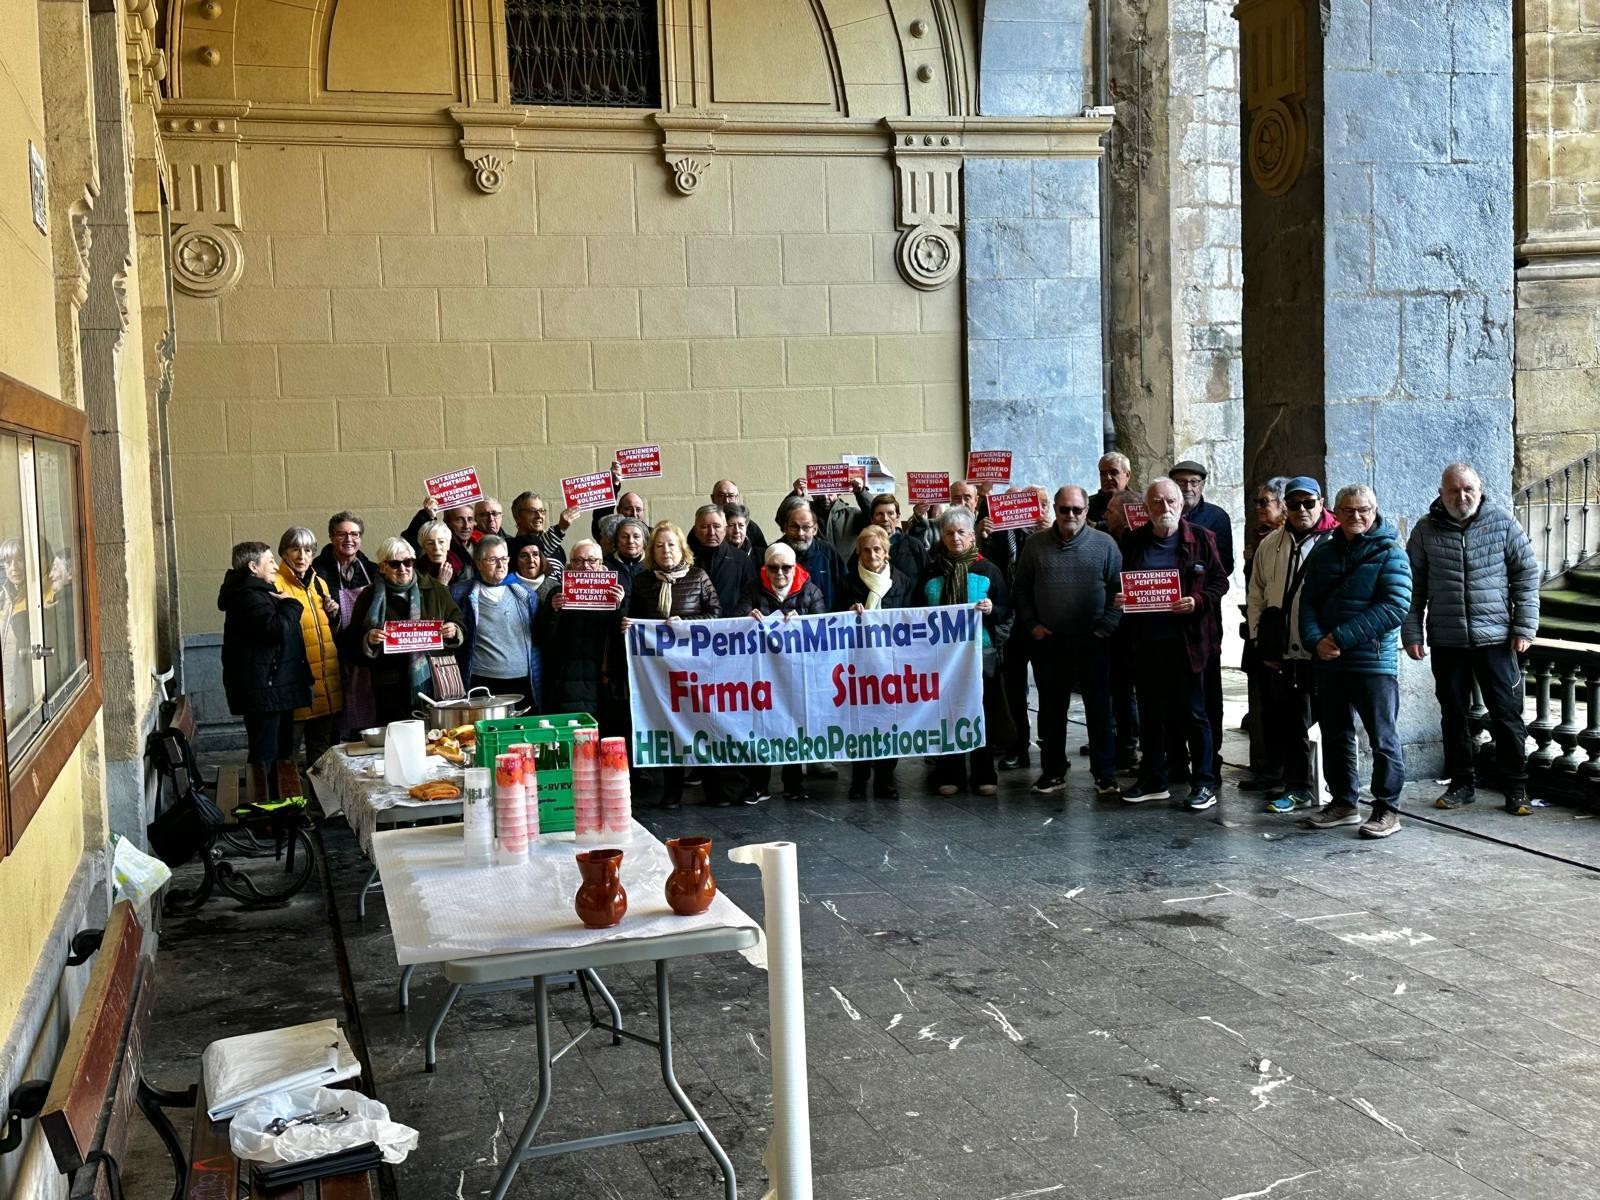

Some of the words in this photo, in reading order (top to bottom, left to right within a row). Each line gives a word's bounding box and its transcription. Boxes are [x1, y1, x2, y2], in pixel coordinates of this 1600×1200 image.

[1126, 571, 1178, 580] GUTXIENEKO
[1134, 578, 1172, 586] PENTSIOA
[1128, 588, 1178, 597] GUTXIENEKO
[1136, 595, 1172, 604] SOLDATA
[668, 670, 772, 713] Firma
[832, 662, 940, 708] Sinatu
